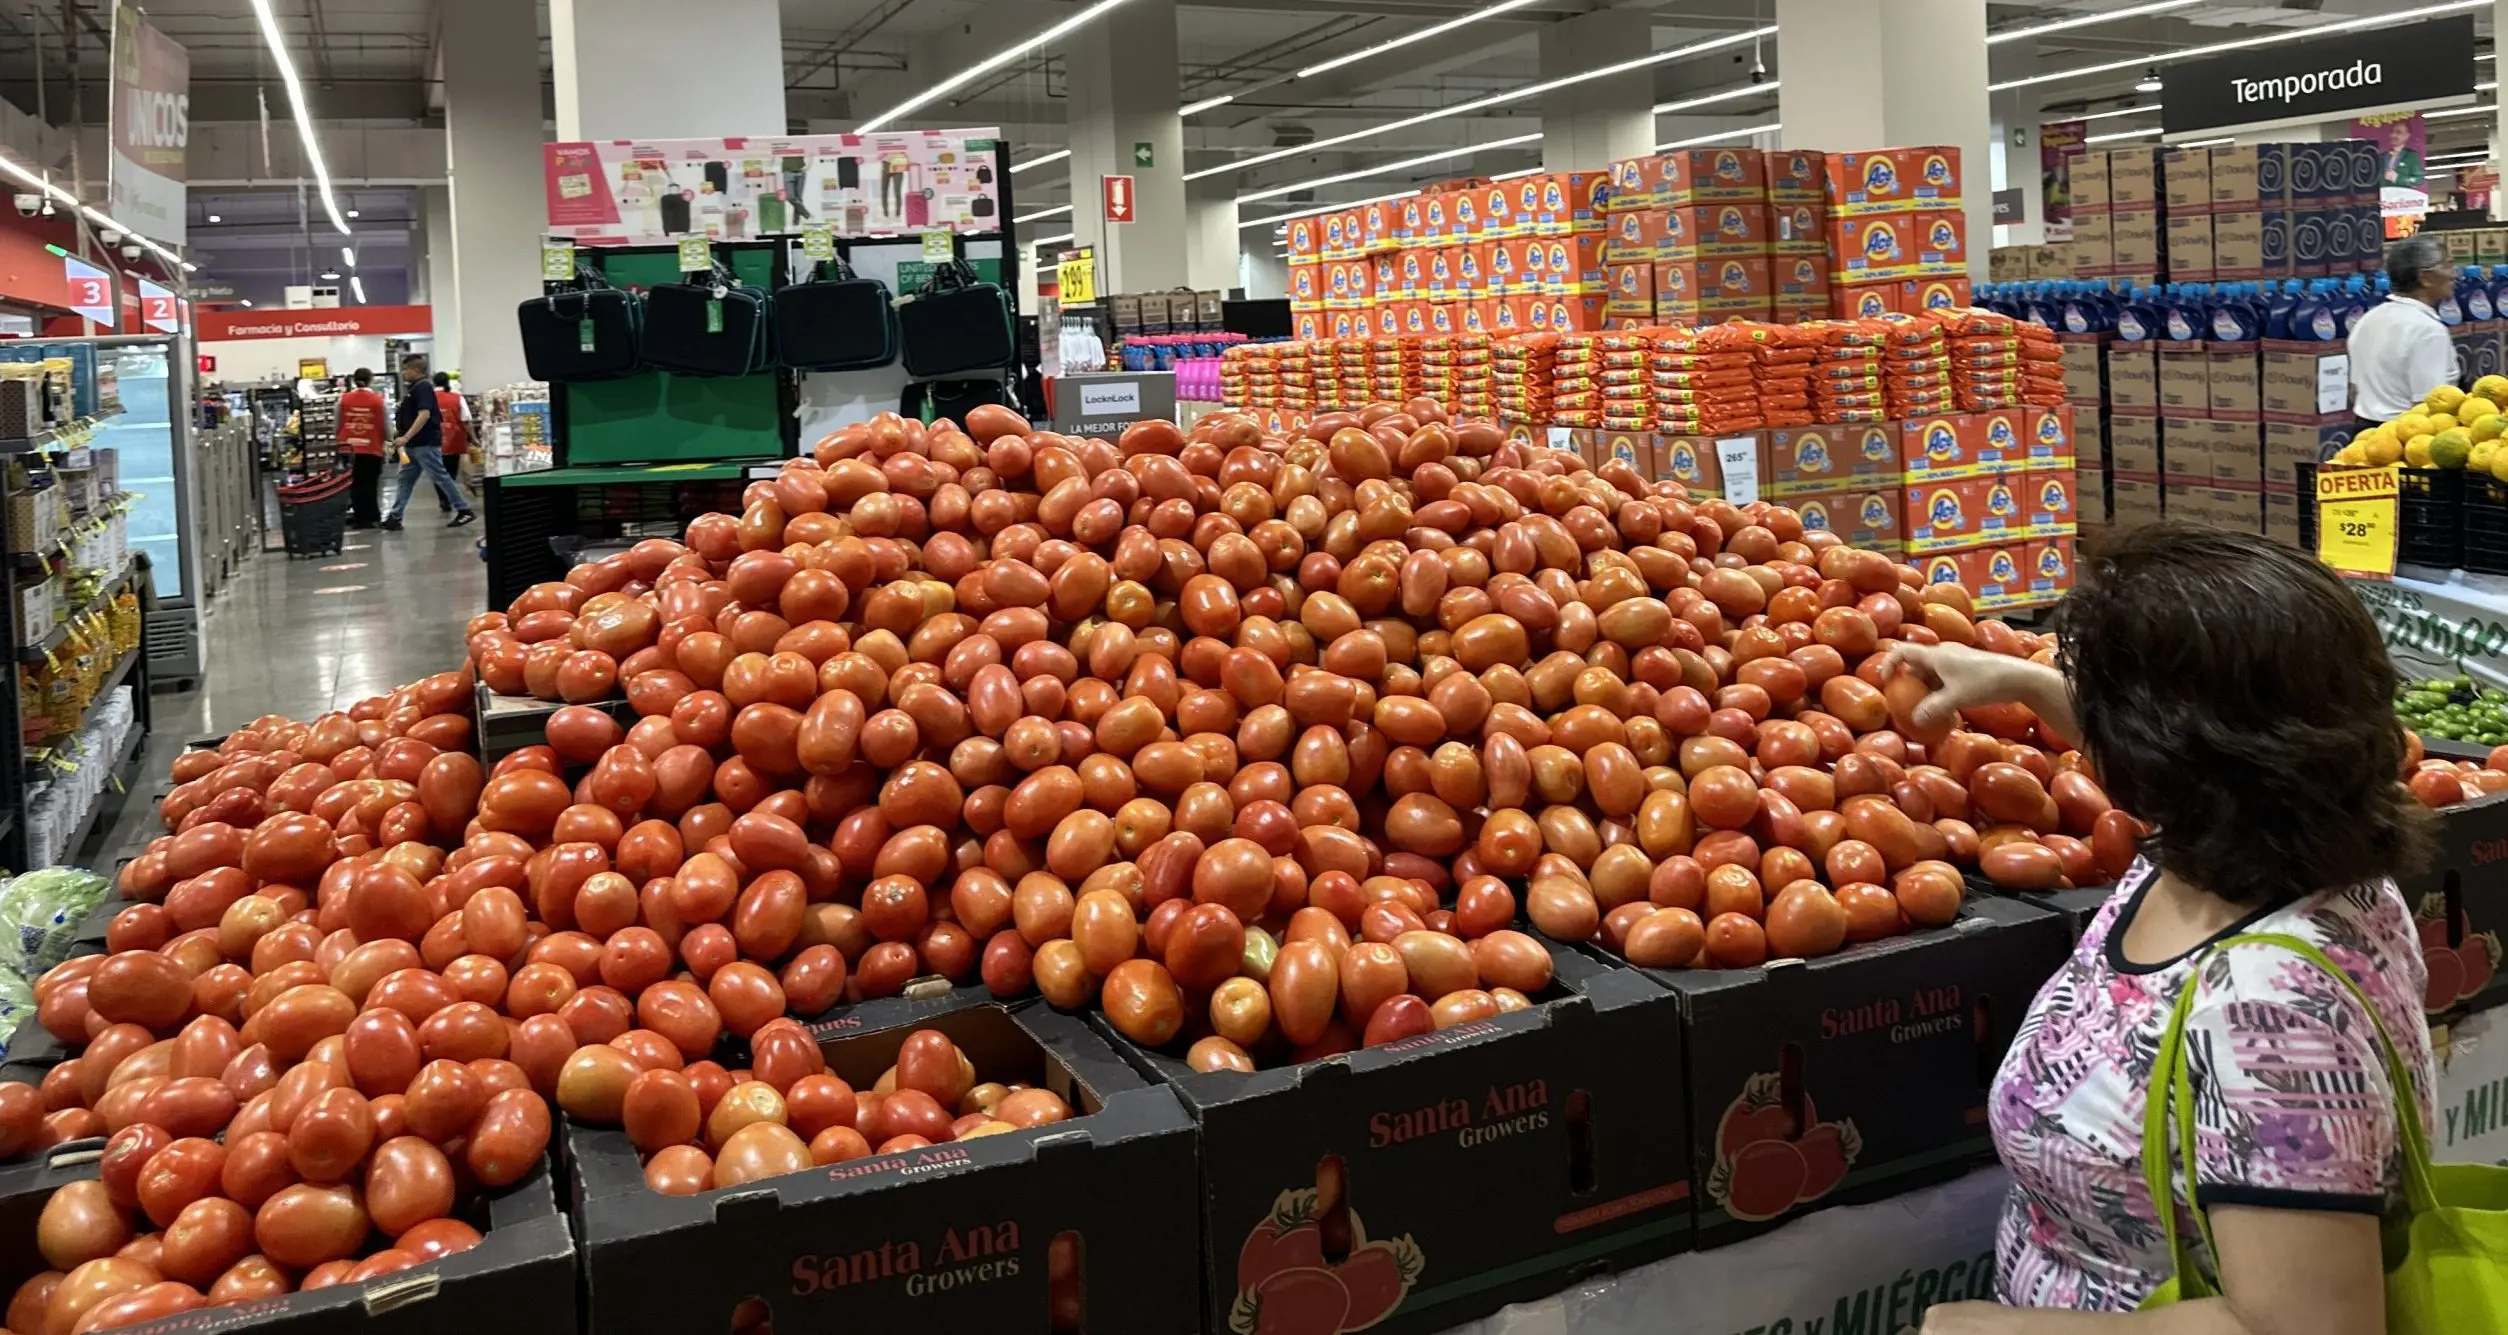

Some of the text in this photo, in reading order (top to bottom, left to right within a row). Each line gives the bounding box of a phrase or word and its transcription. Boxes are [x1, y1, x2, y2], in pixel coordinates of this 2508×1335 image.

[2231, 59, 2381, 103] Temporada
[1864, 166, 1893, 188] Ace
[1865, 231, 1893, 253] Ace
[82, 281, 101, 305] 3
[153, 299, 169, 318] 2
[228, 323, 283, 336] Farmacia
[294, 320, 360, 334] Consultorio
[1070, 423, 1083, 434] LA
[1084, 422, 1116, 434] MEJOR
[1927, 430, 1954, 453] Ace
[2320, 471, 2396, 494] OFERTA
[1931, 499, 1957, 522] Ace
[1821, 984, 1962, 1040] Santa Ana
[1890, 1013, 1962, 1044] Growers
[1383, 1033, 1447, 1053] Santa
[1369, 1078, 1549, 1148] Santa Ana
[1458, 1110, 1549, 1149] Growers
[2445, 1105, 2460, 1147] Y
[828, 1147, 969, 1182] Santa Ana
[900, 1158, 972, 1176] Growers
[792, 1219, 1021, 1296] Santa Ana
[906, 1256, 1020, 1297] Growers
